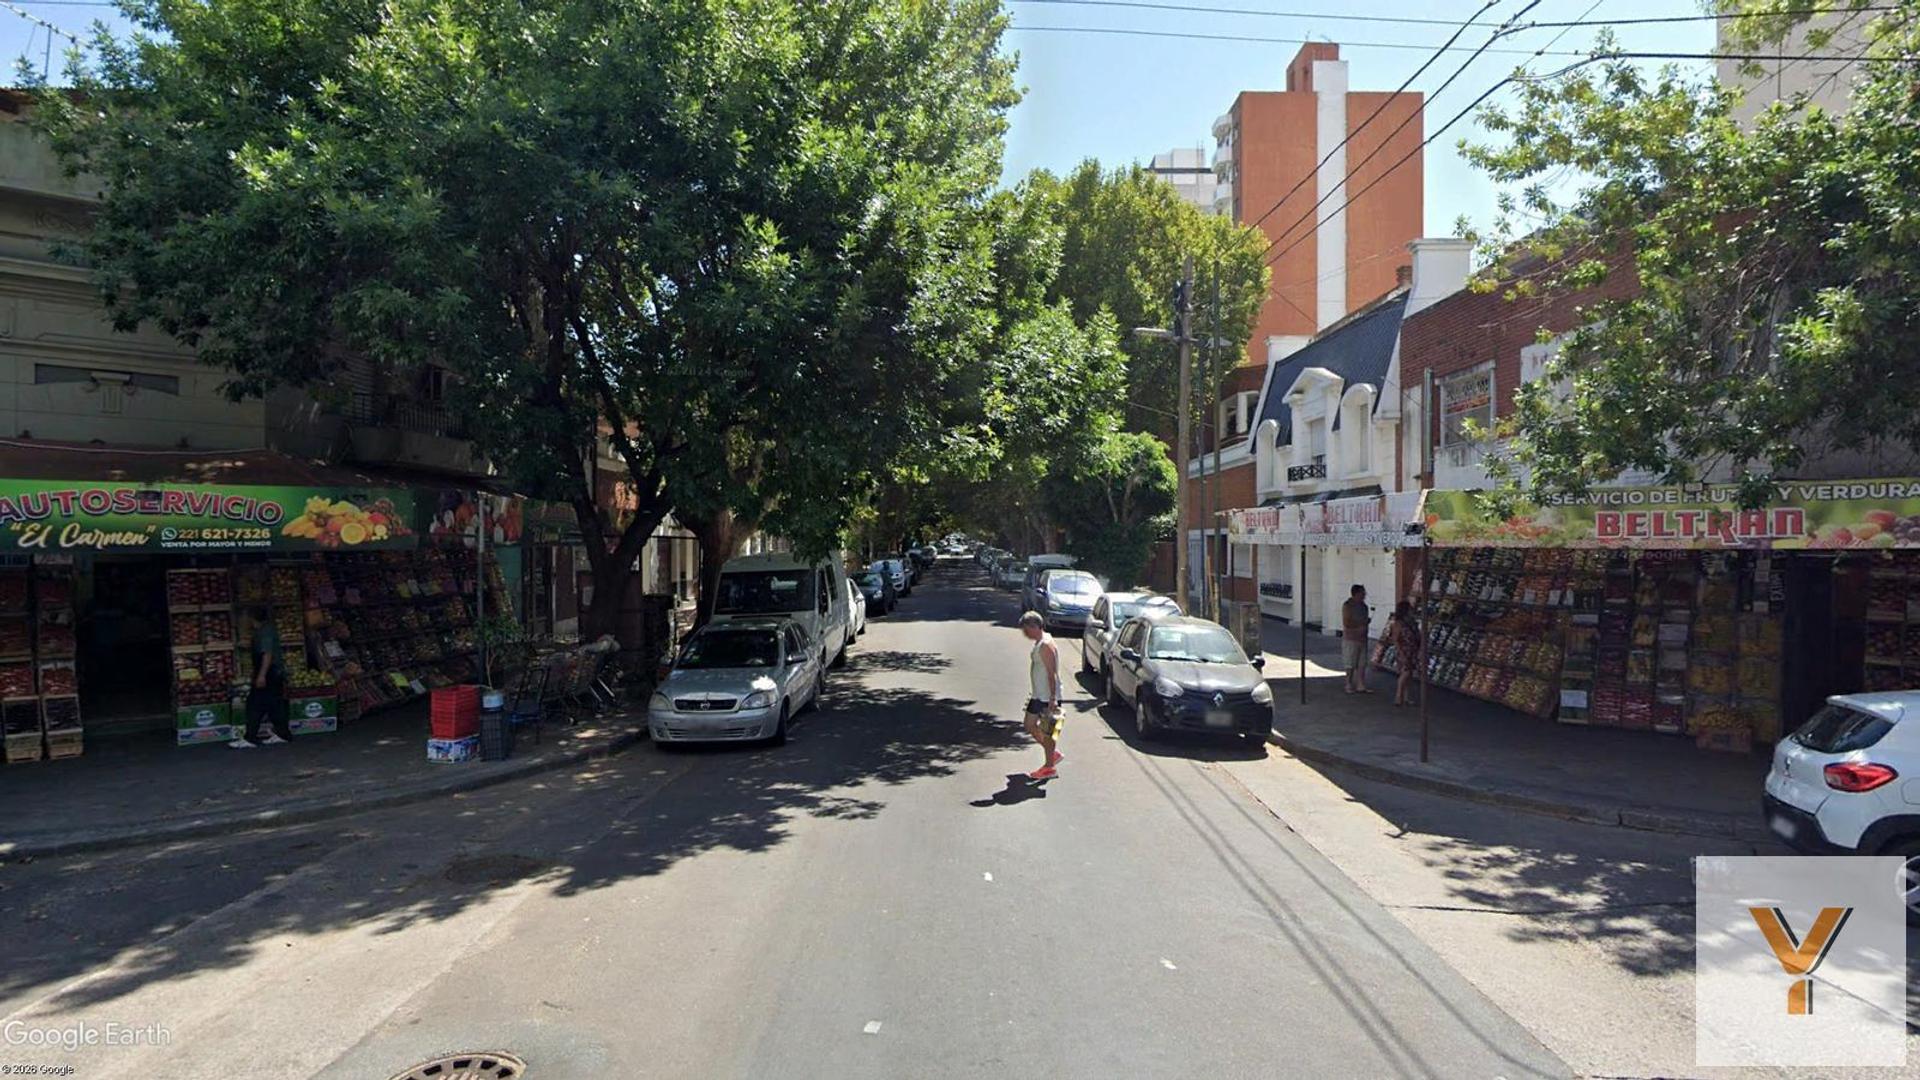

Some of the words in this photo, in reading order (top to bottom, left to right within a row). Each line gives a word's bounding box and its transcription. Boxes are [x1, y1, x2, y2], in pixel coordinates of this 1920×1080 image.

[0, 488, 284, 525] AUTOSERVICIO
[1650, 490, 1677, 503] DE
[1778, 486, 1796, 500] Y
[1801, 483, 1920, 500] VERDURA
[178, 529, 199, 539] 221
[201, 528, 271, 539] 621-7326
[1595, 508, 1805, 545] BELTRAN
